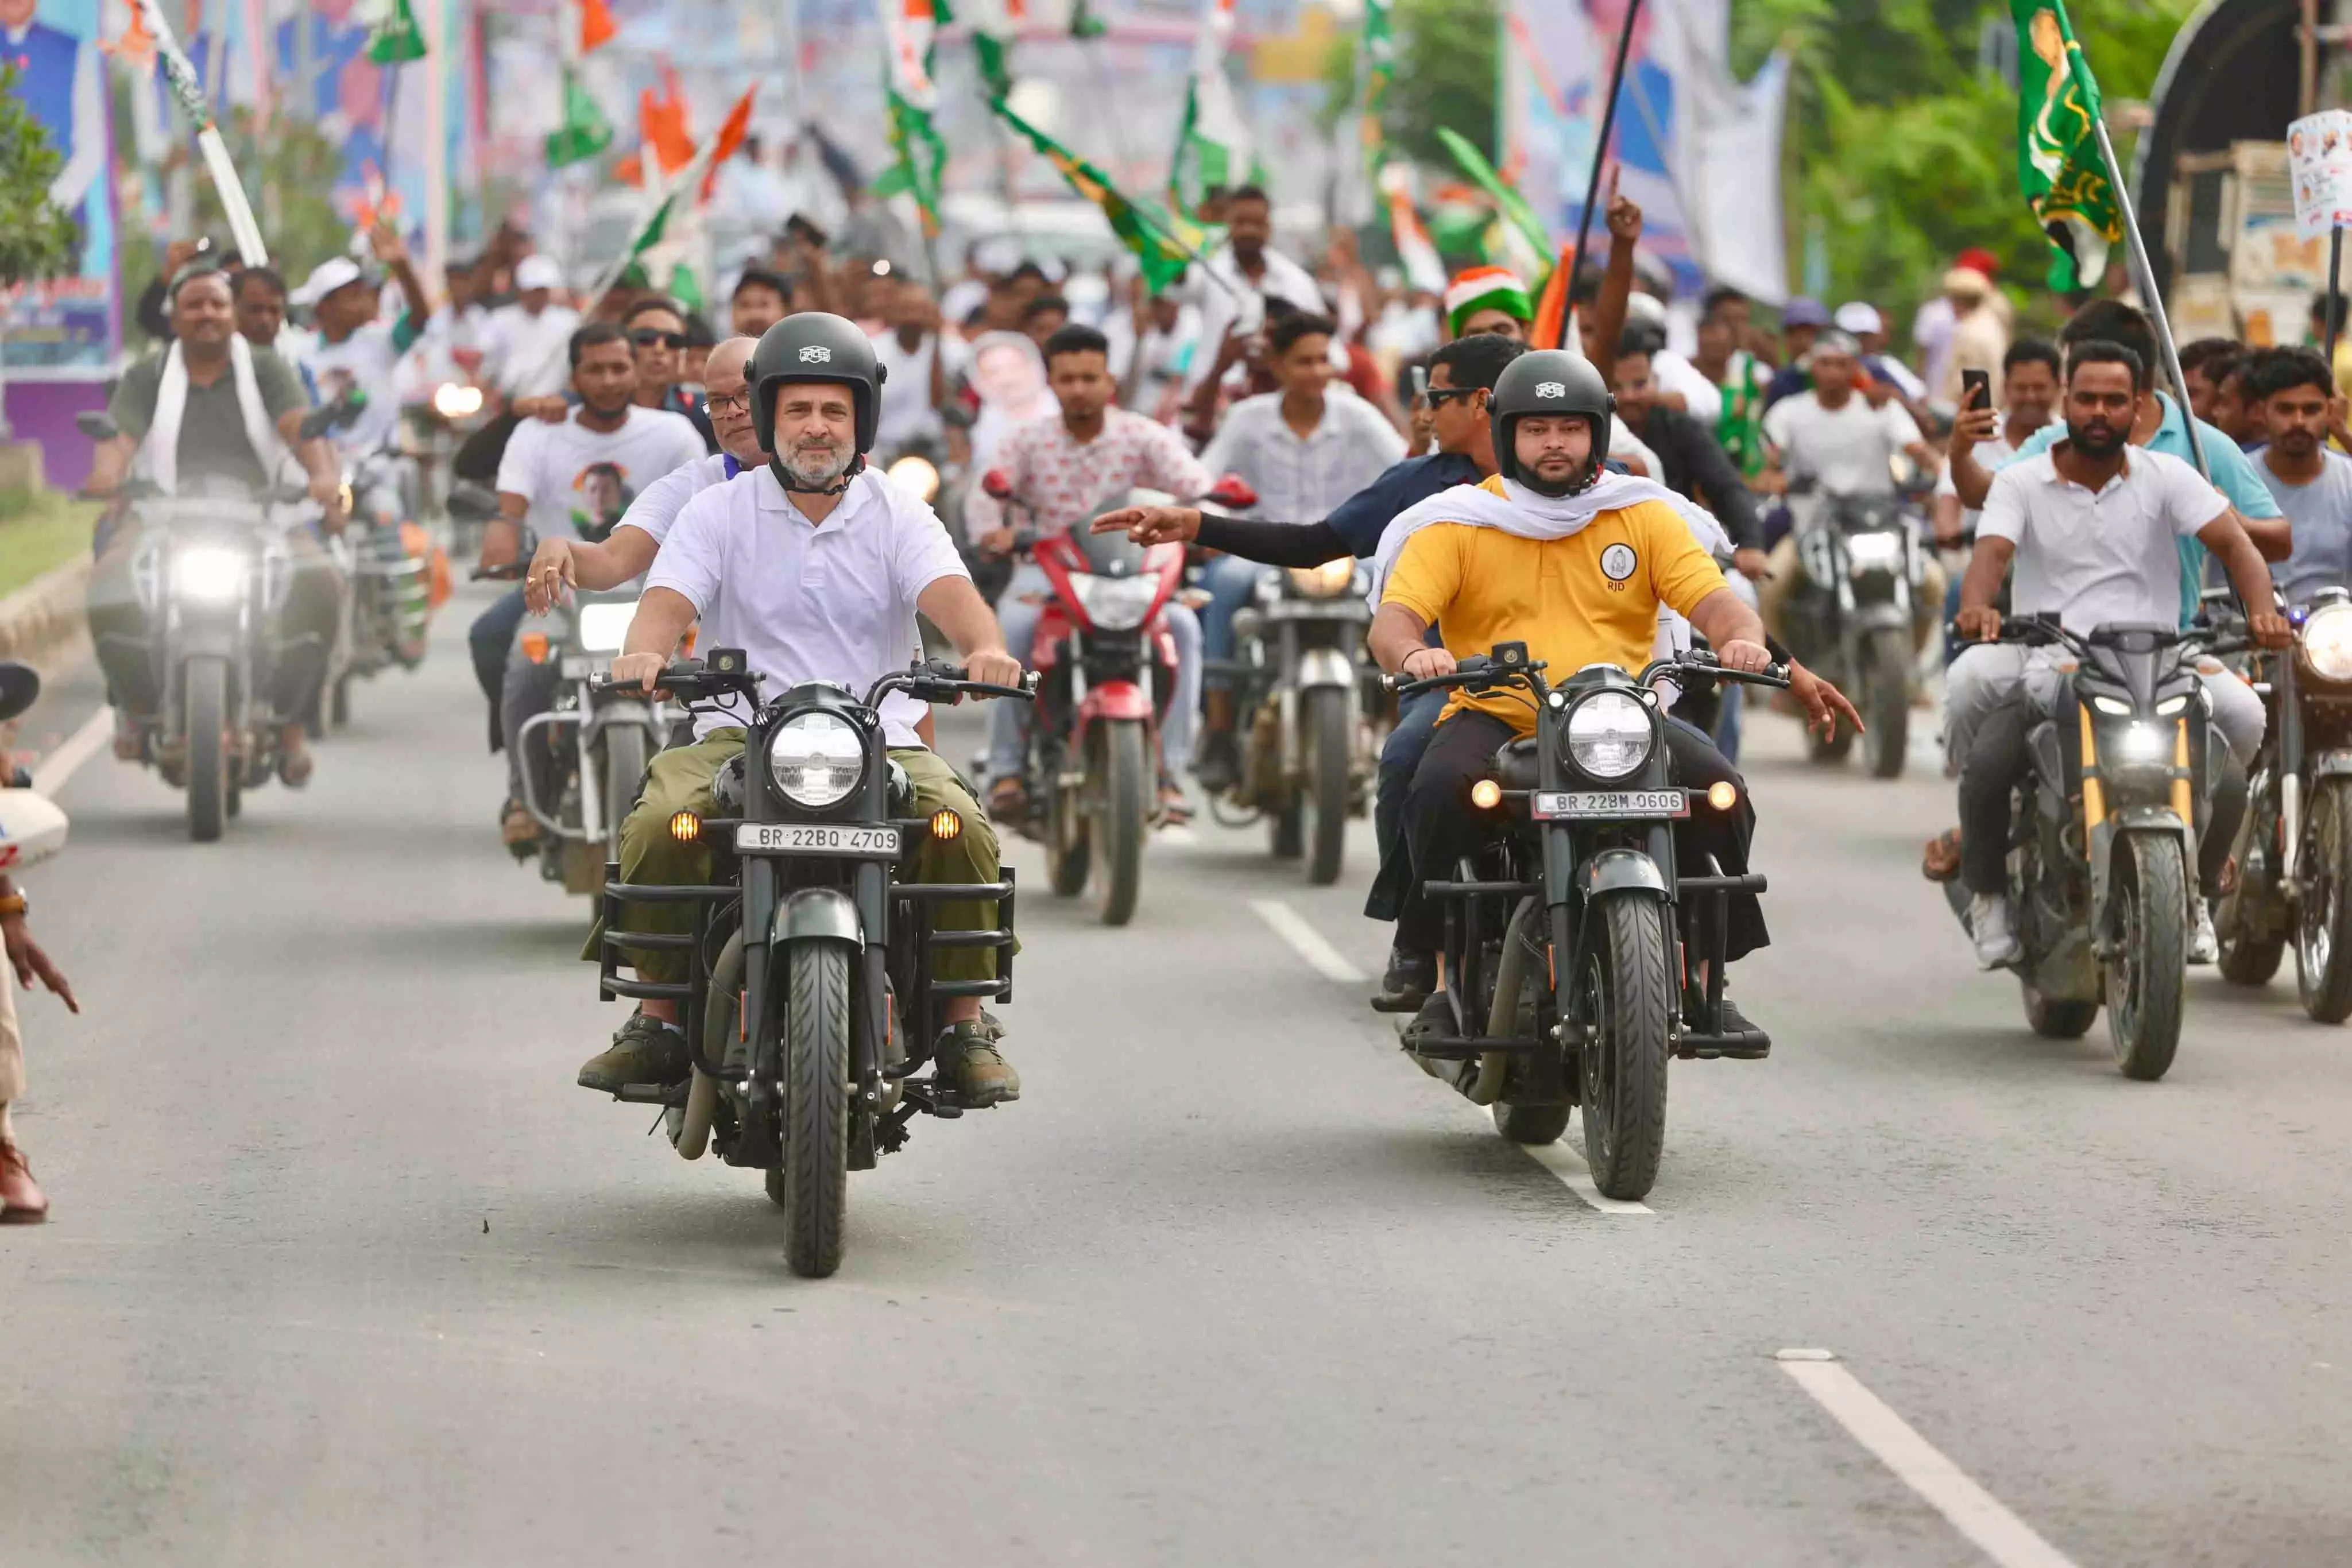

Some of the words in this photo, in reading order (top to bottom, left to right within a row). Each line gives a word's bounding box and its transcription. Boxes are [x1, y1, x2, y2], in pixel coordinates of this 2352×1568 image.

[1608, 582, 1624, 592] RJD
[1557, 796, 1577, 810] BR
[1637, 793, 1680, 808] 0606
[760, 828, 782, 845] BR
[850, 833, 896, 848] 4709
